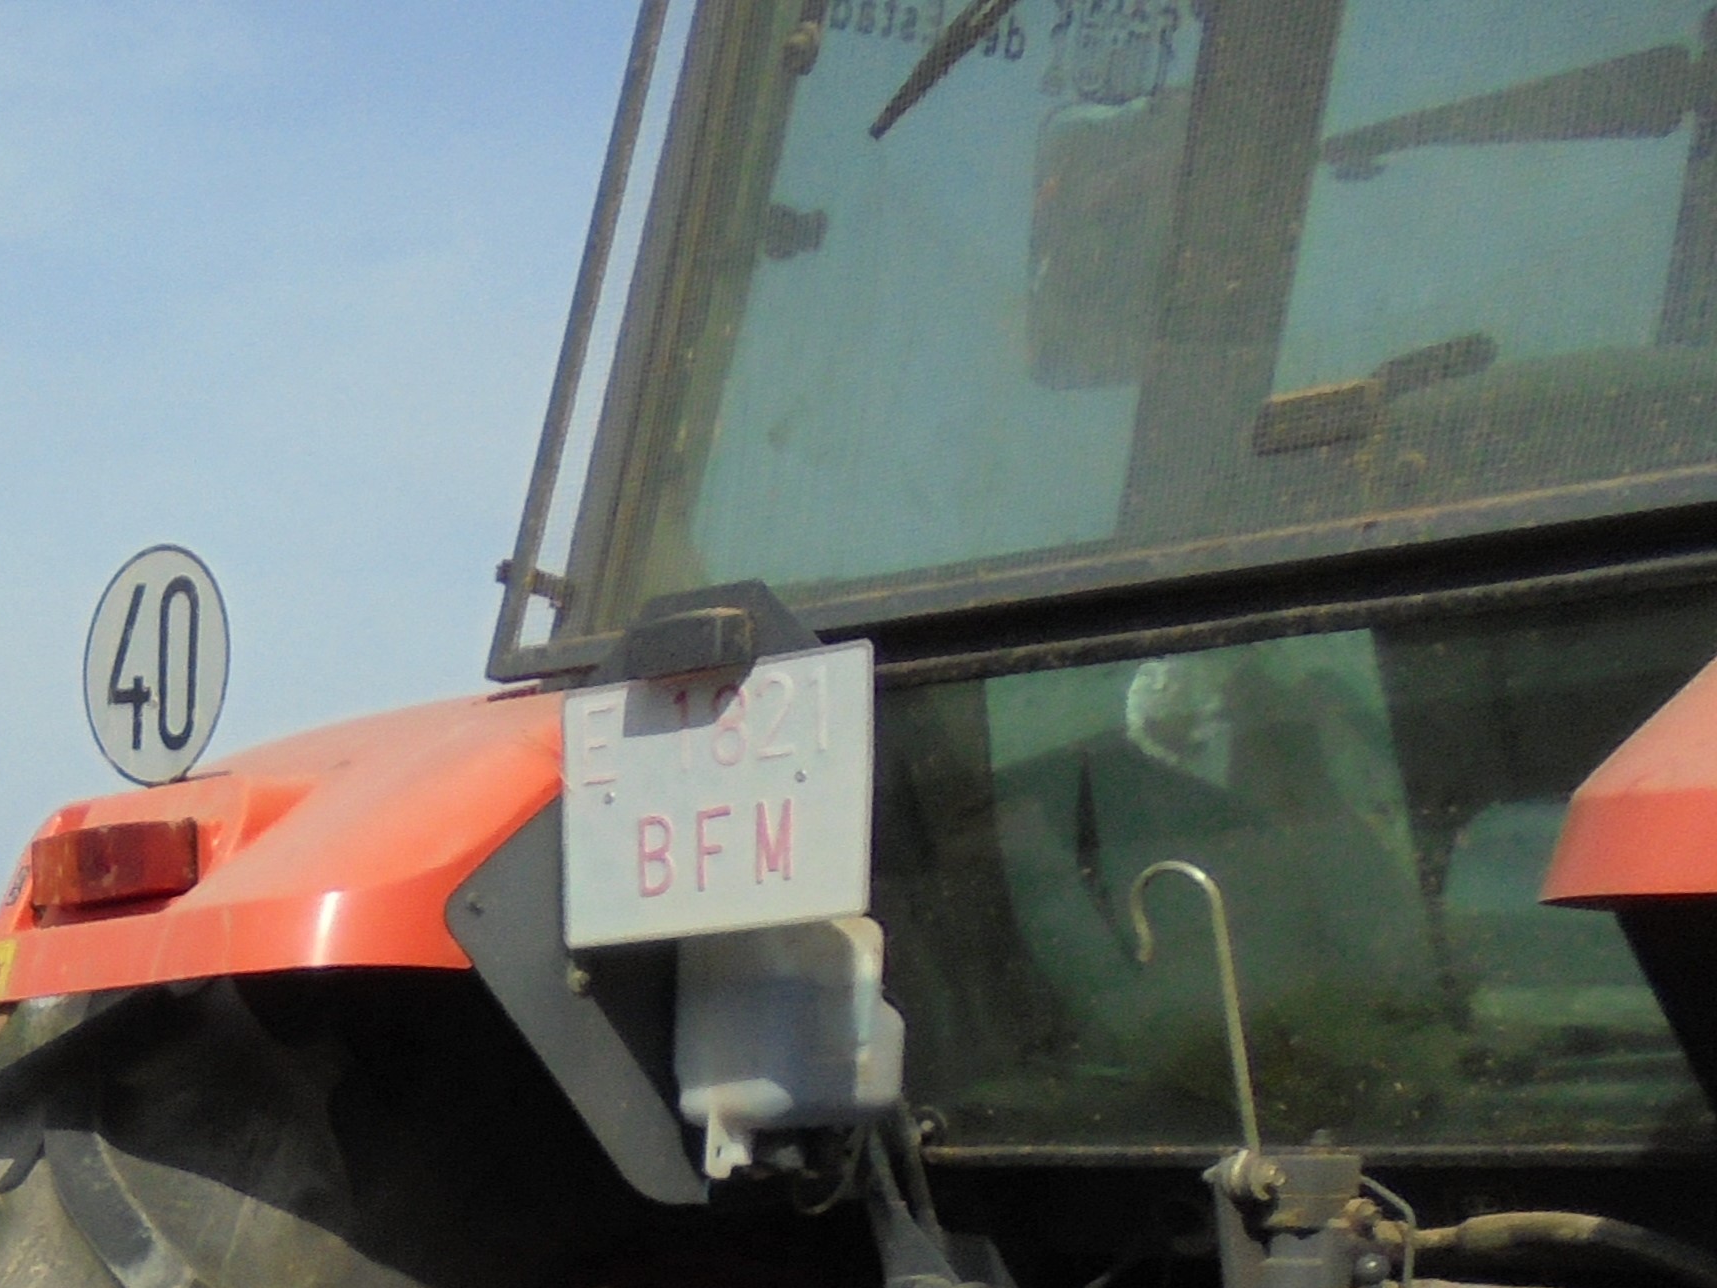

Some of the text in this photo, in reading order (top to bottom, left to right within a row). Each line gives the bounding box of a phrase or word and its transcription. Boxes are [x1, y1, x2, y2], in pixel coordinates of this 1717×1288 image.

[107, 574, 200, 752] 40
[672, 663, 830, 773] 1821
[635, 798, 794, 898] BFM
